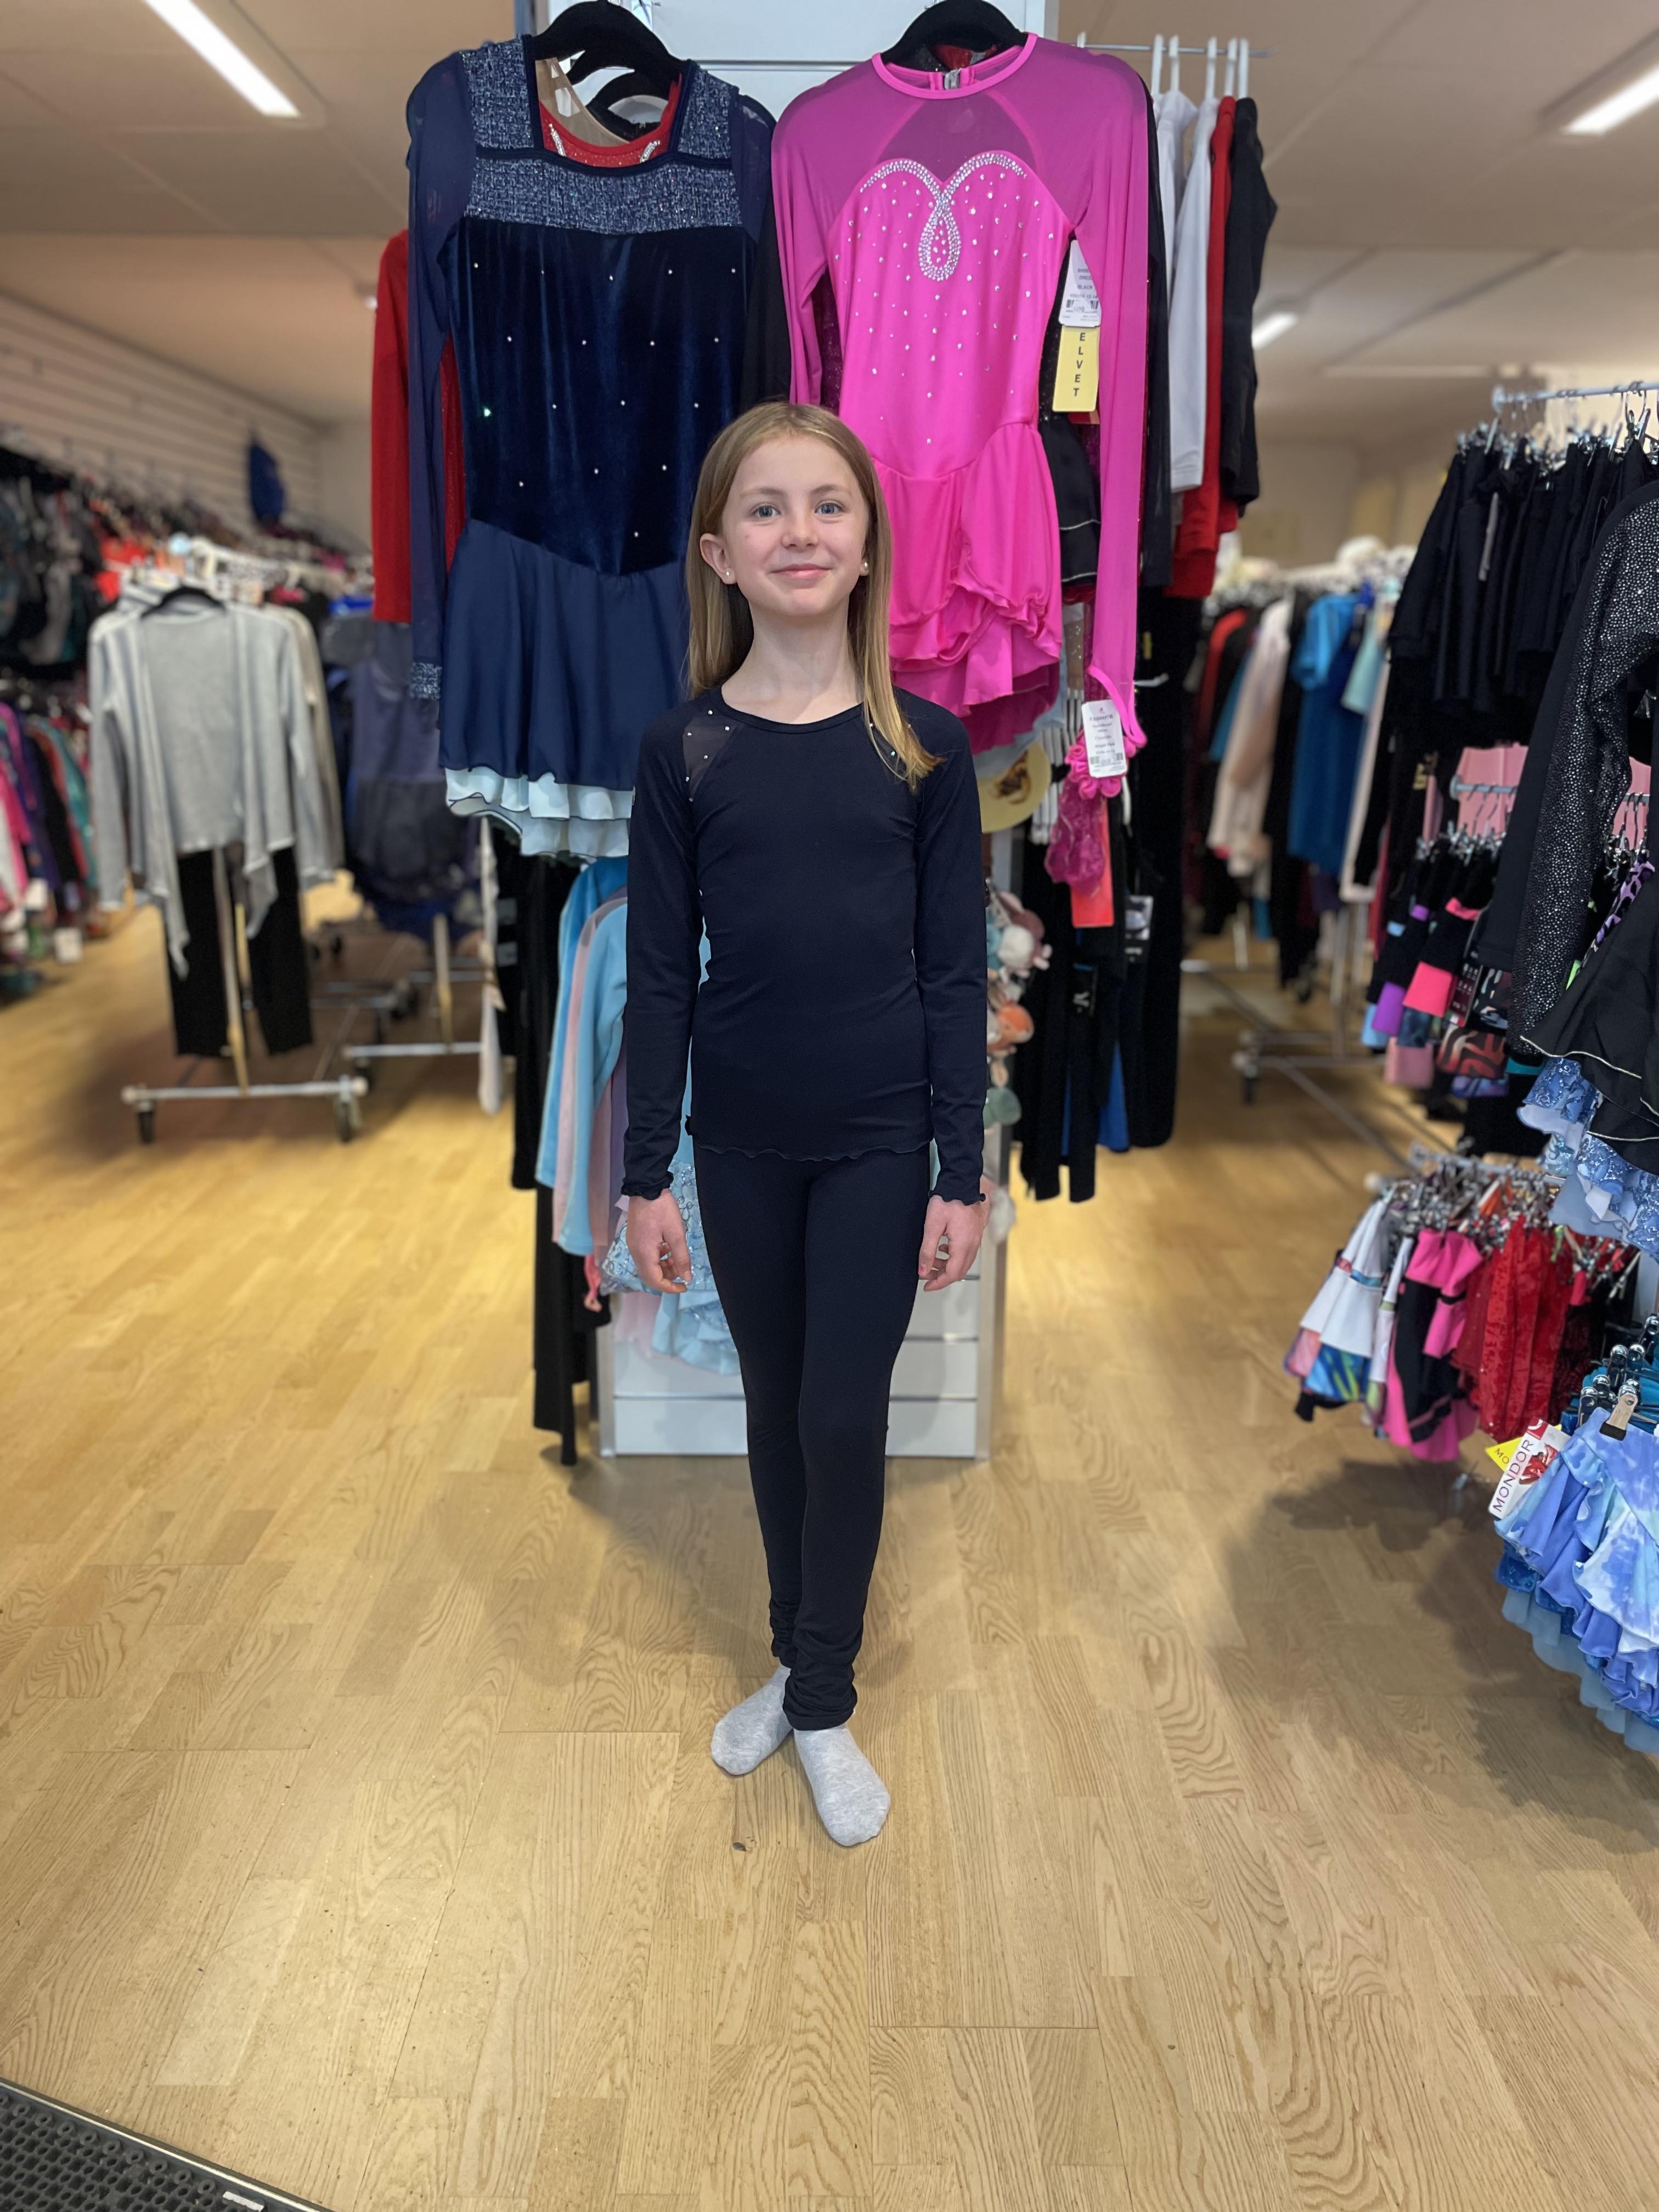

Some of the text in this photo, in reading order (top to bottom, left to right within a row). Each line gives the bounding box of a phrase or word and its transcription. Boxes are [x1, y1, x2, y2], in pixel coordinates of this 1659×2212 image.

[1073, 332, 1086, 397] ELVET
[1493, 1440, 1533, 1512] MONDOR
[1494, 1448, 1509, 1464] MO
